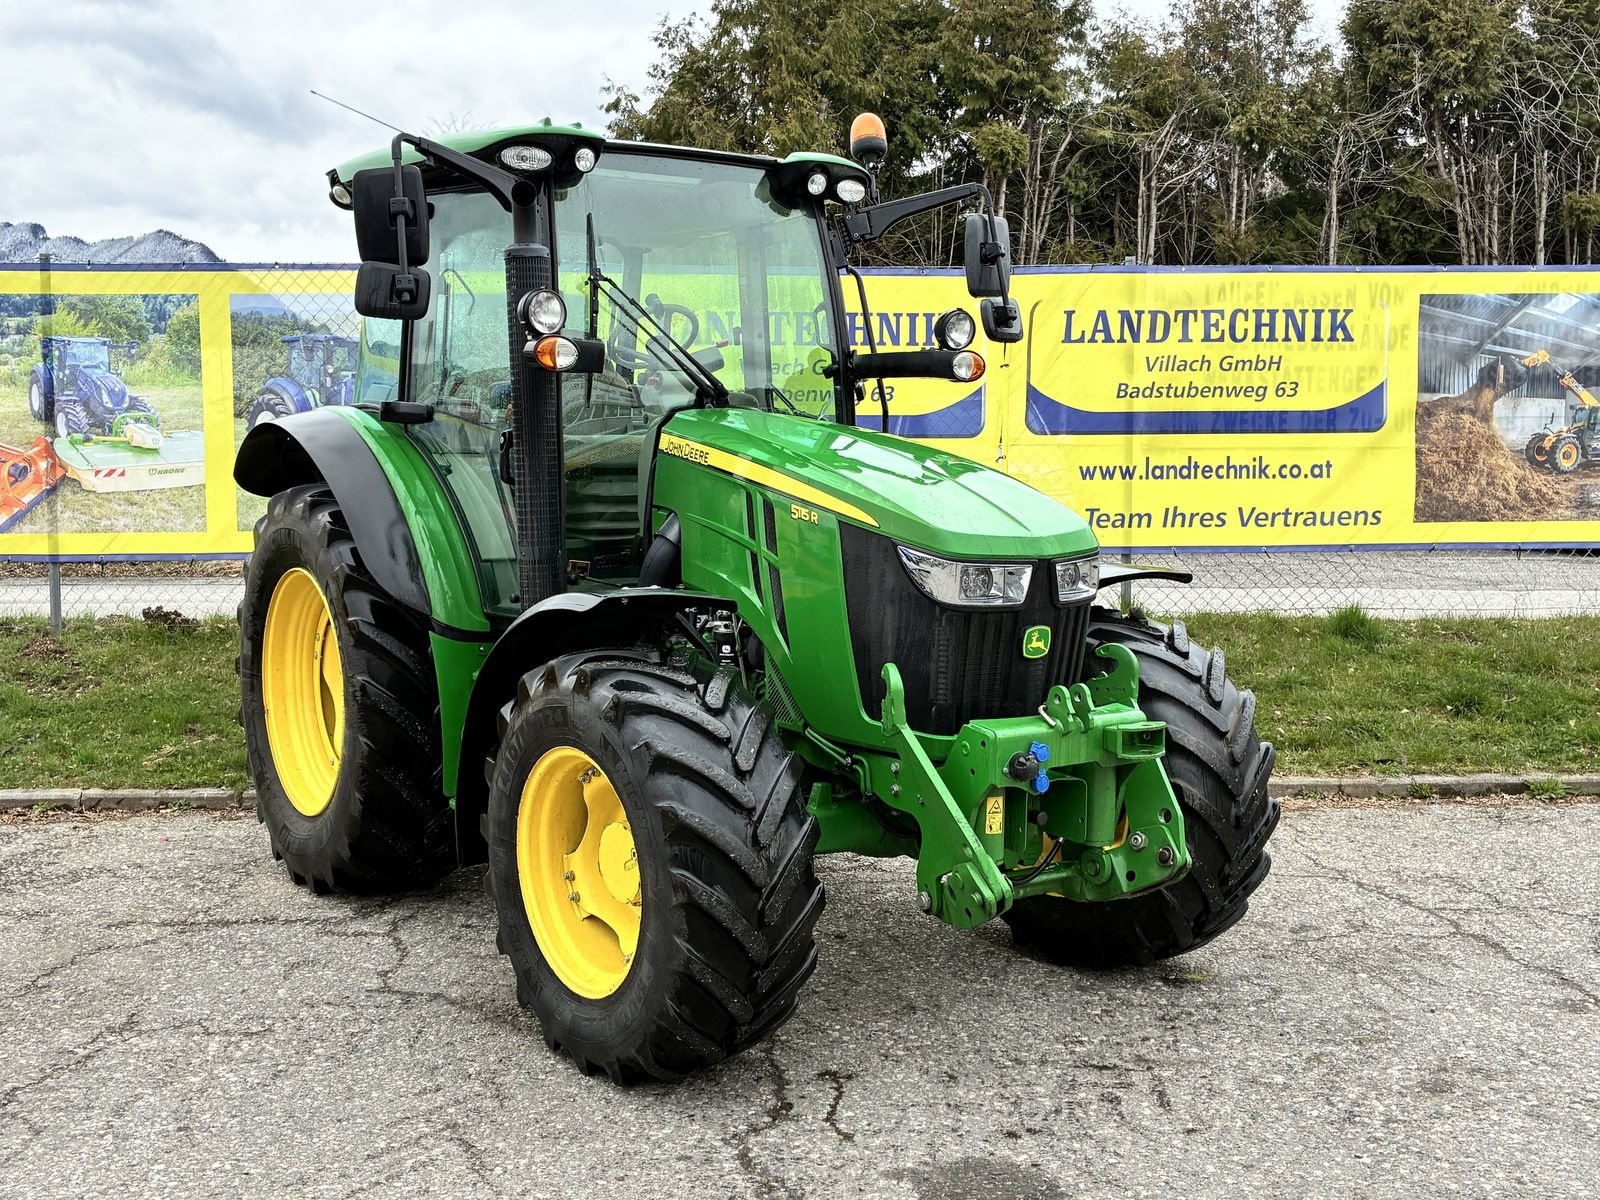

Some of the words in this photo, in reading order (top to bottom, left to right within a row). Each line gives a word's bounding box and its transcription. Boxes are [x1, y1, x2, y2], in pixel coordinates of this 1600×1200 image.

[1062, 309, 1355, 343] LANDTECHNIK
[1145, 355, 1212, 372] Villach
[1219, 355, 1282, 372] GmbH
[1116, 381, 1268, 402] Badstubenweg
[1275, 381, 1299, 398] 63
[665, 438, 684, 457] JOHN
[684, 443, 710, 464] DEERE
[1079, 455, 1333, 480] www.landtechnik.co.at
[1085, 507, 1152, 529] Team
[1162, 506, 1227, 528] Ihres
[1237, 506, 1382, 528] Vertrauens
